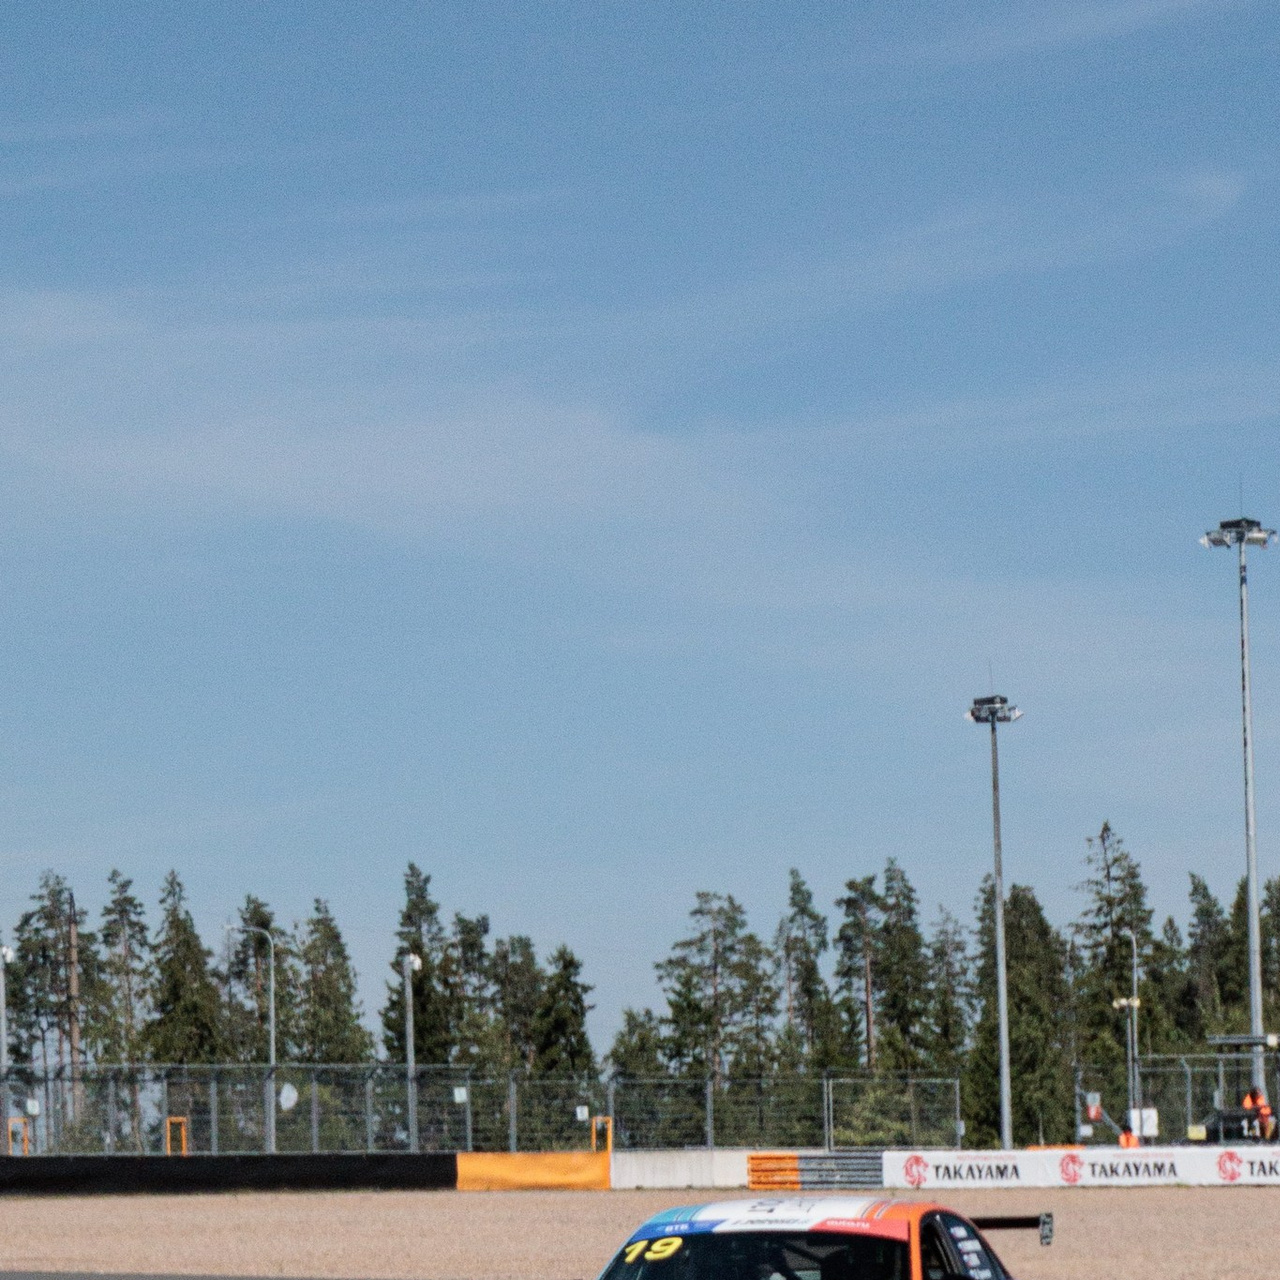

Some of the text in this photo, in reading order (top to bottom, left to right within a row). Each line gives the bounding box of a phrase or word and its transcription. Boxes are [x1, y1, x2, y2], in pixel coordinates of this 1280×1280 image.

[933, 1163, 1020, 1180] TAKAYAMA
[1088, 1161, 1178, 1178] TAKAYAMA
[624, 1236, 684, 1264] 19
